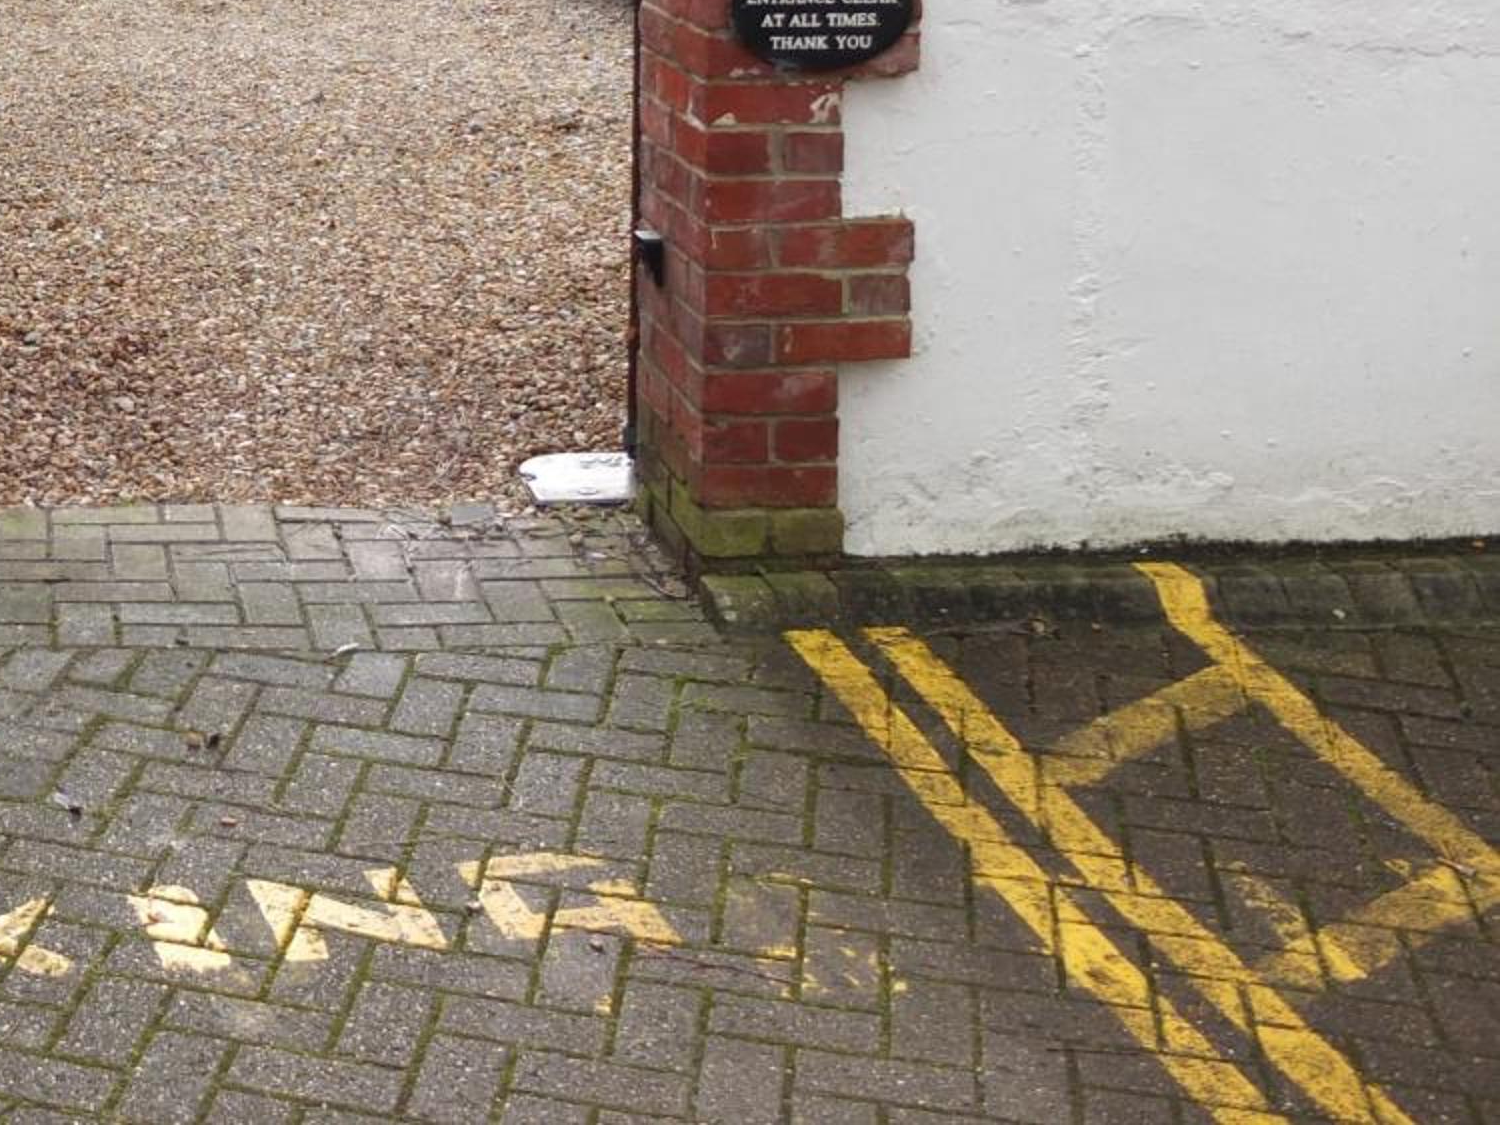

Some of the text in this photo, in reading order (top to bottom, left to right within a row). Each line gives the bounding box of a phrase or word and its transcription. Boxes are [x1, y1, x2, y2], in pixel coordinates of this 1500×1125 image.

[761, 13, 786, 27] AT
[789, 14, 820, 27] ALL
[770, 35, 872, 50] THANK YOU
